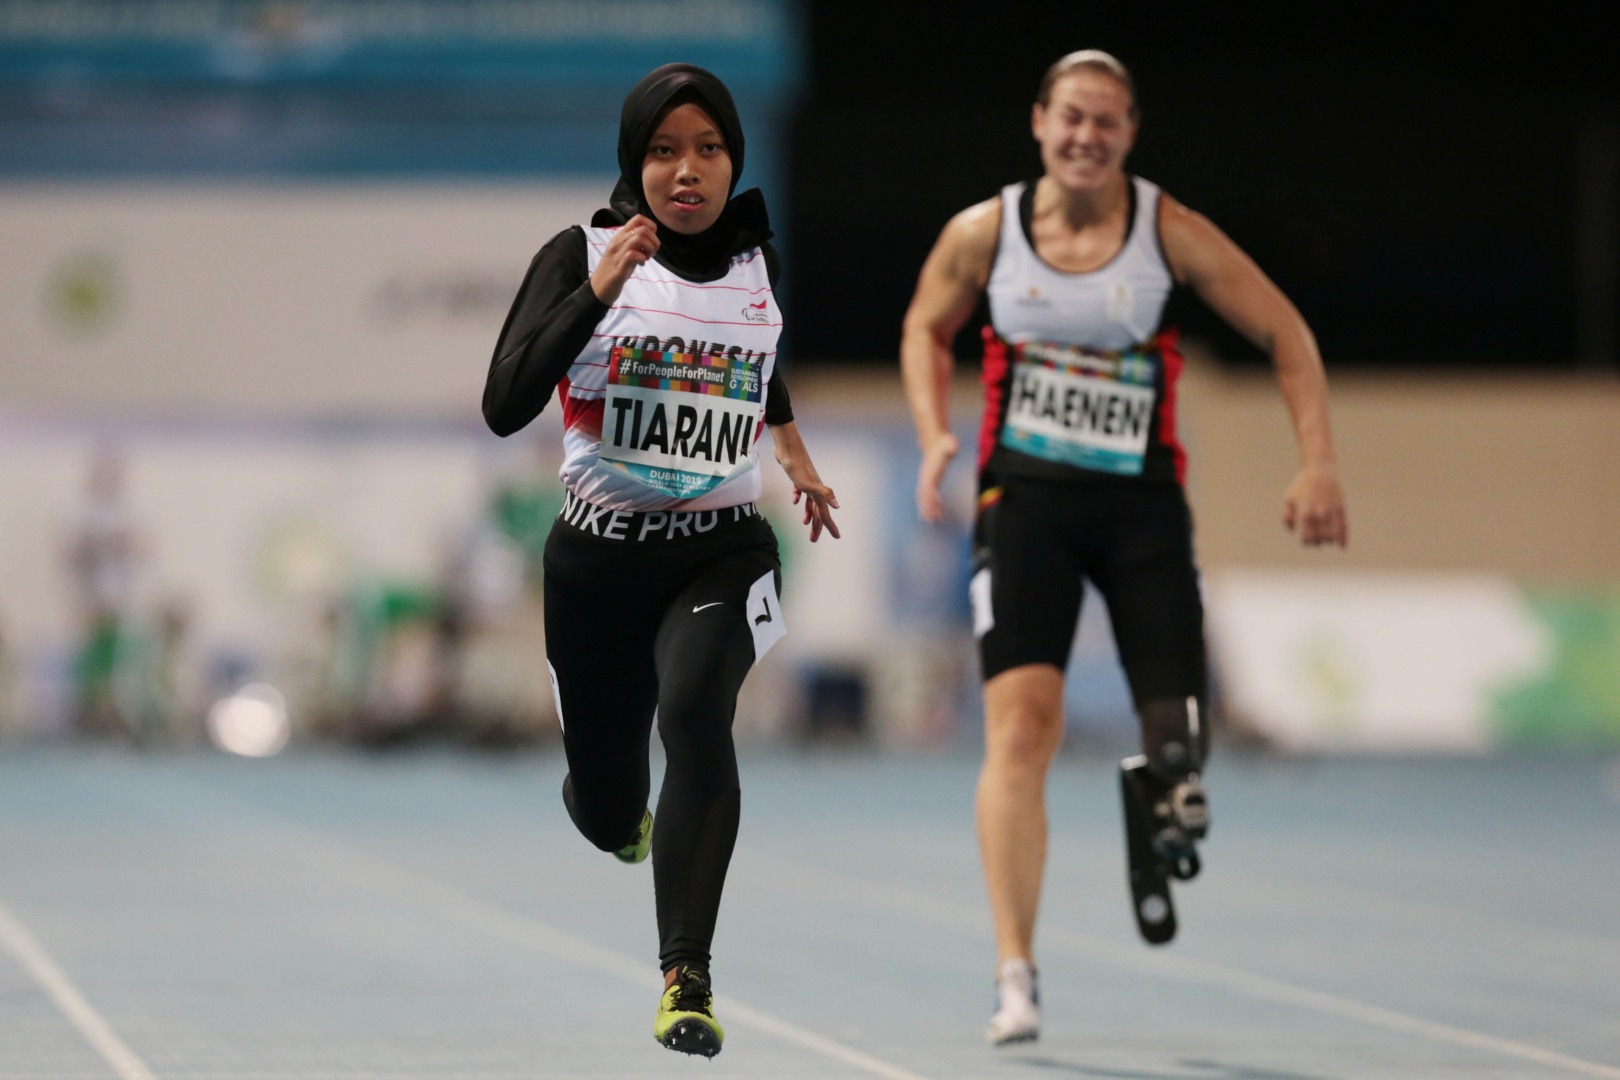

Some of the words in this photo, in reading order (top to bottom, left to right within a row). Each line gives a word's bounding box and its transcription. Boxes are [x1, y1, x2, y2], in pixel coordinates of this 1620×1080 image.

[619, 358, 725, 383] #ForPeopleForPlanet
[612, 397, 754, 465] TIARANI
[1016, 373, 1146, 438] HAENEN
[649, 470, 680, 482] DUBAI
[681, 474, 702, 485] 2019
[560, 490, 634, 540] NIKE
[637, 510, 718, 542] PRO
